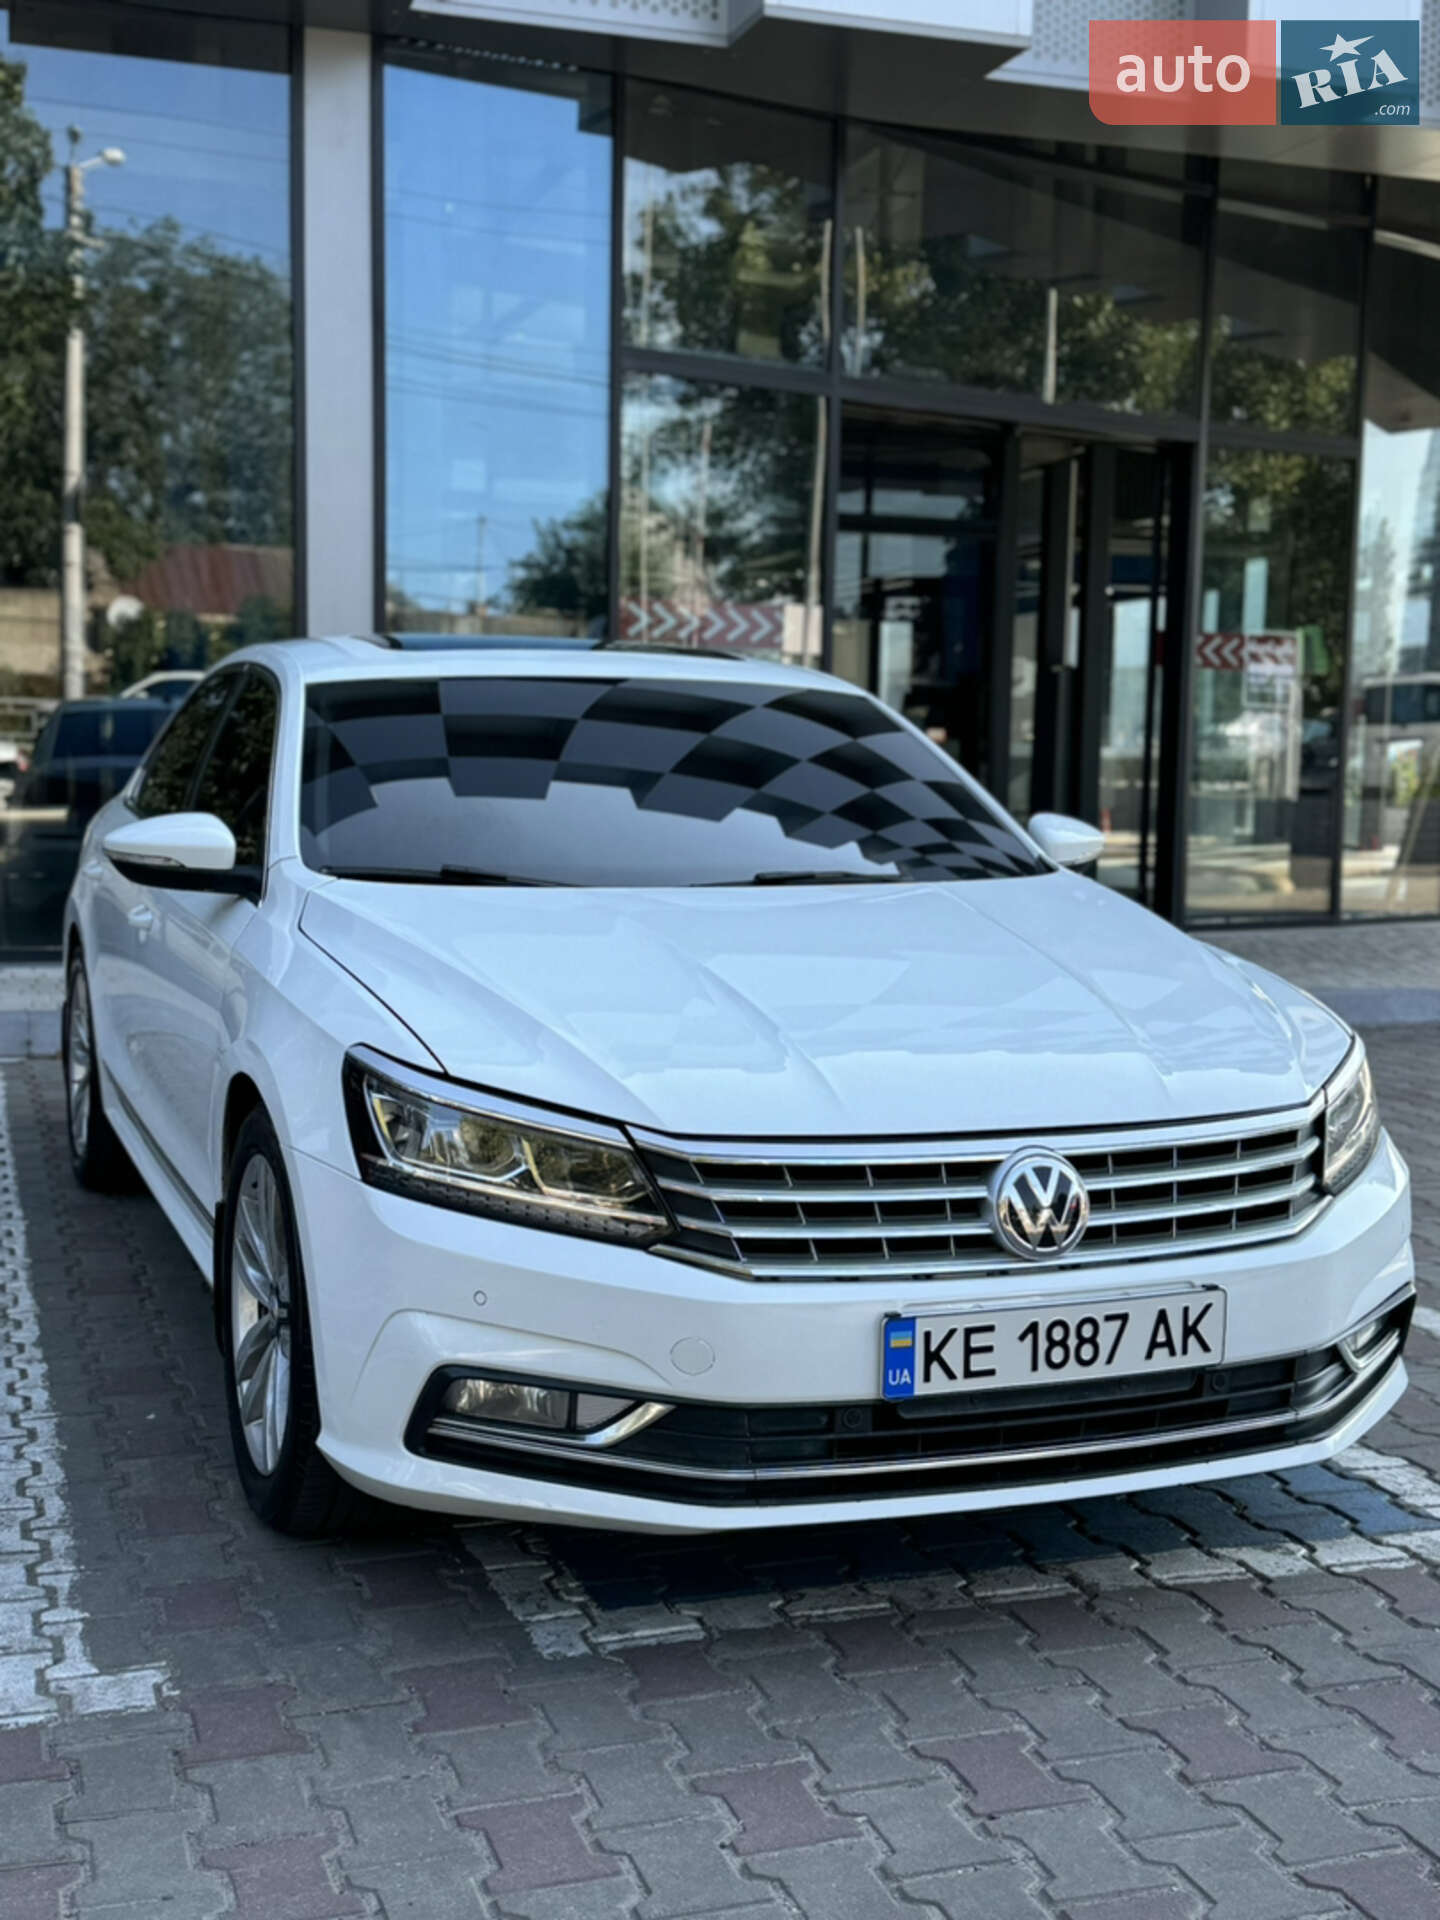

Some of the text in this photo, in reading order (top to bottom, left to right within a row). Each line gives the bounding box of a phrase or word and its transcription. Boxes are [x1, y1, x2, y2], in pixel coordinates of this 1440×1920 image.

[922, 1302, 1214, 1383] KE 1887 AK
[887, 1368, 912, 1386] UA
